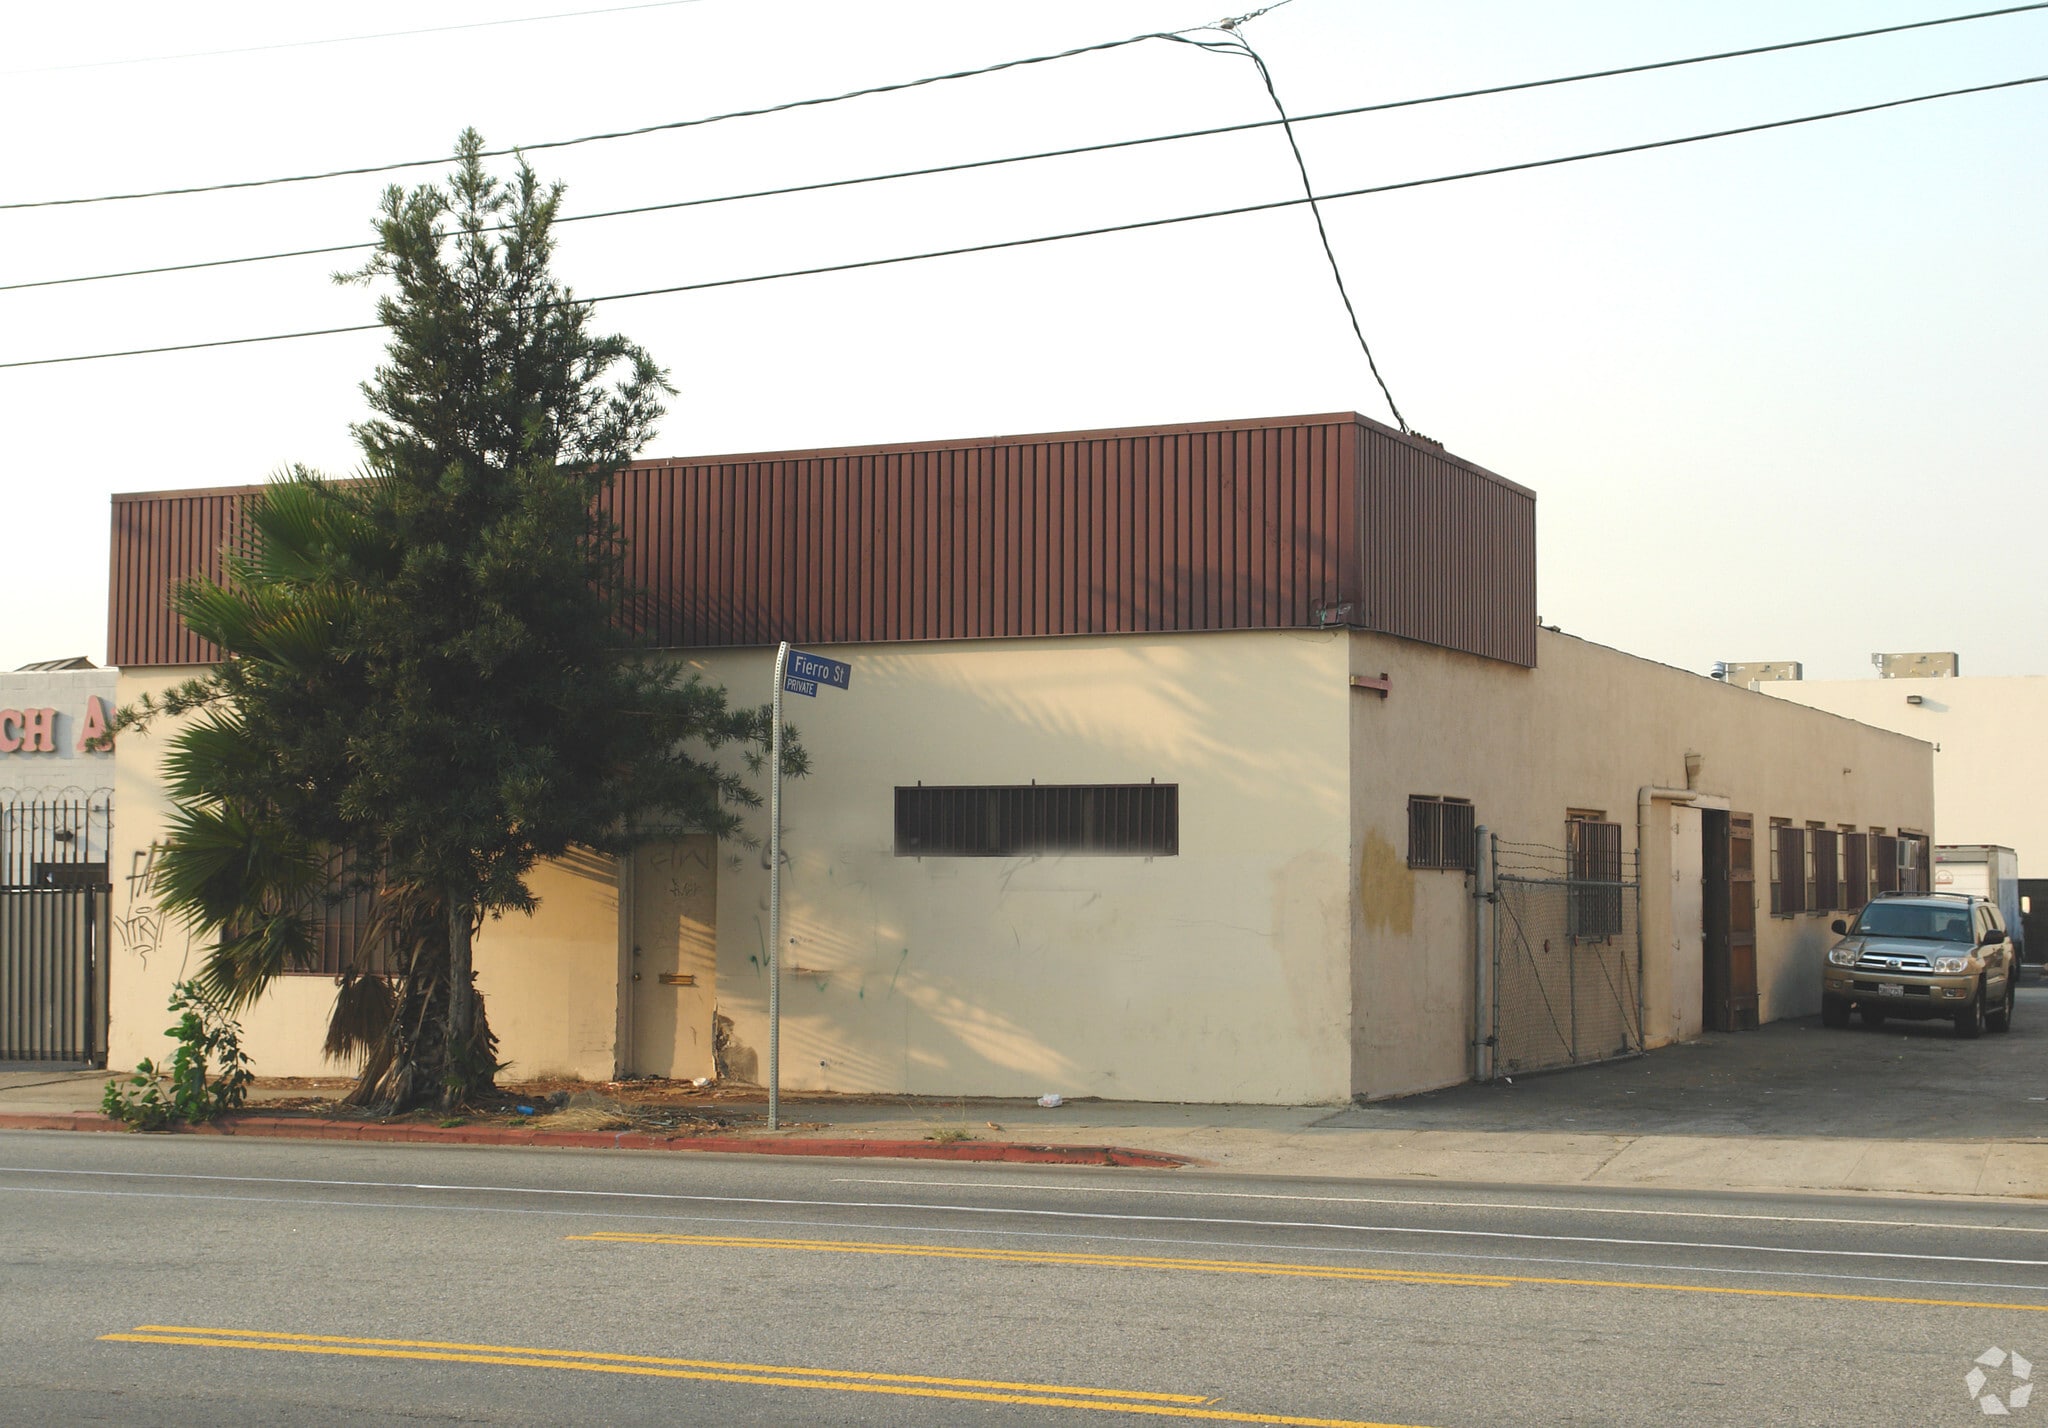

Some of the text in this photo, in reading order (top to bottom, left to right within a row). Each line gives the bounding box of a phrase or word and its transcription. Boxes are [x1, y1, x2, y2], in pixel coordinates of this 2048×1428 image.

[795, 655, 844, 683] Fierro St
[786, 679, 815, 695] PRIVATE
[76, 694, 117, 753] A
